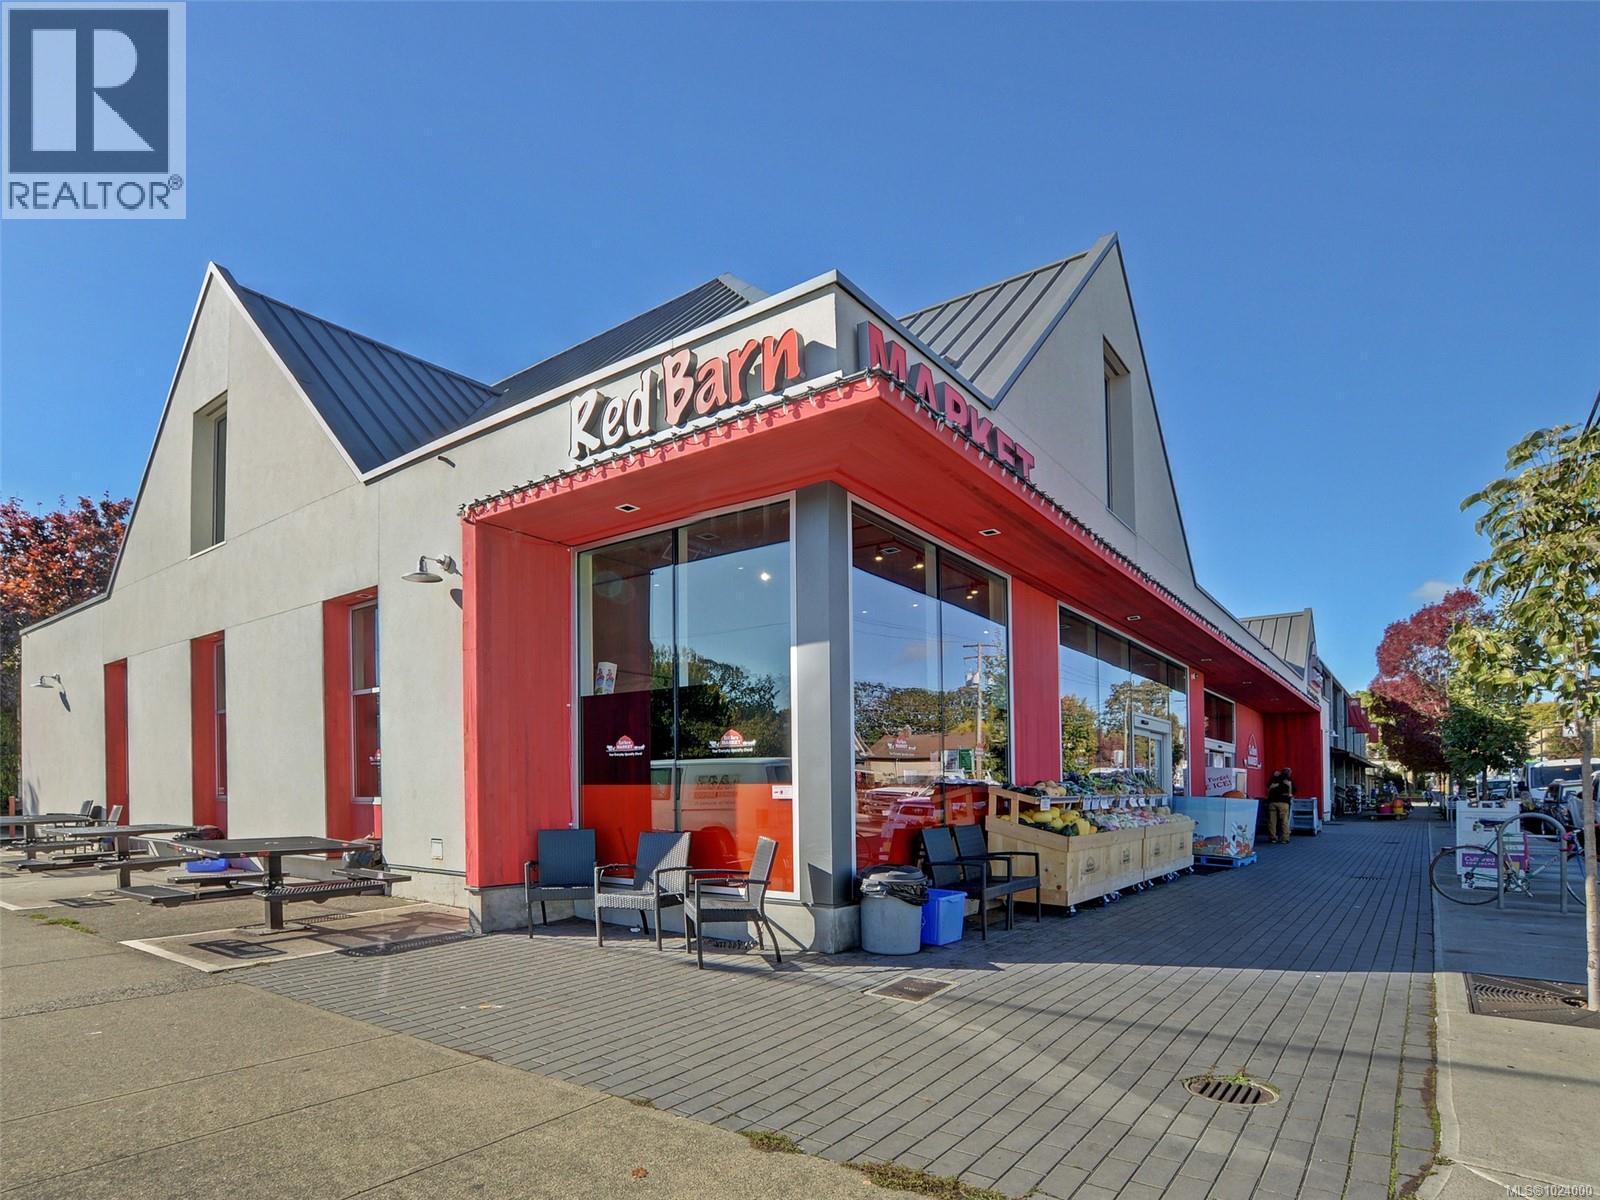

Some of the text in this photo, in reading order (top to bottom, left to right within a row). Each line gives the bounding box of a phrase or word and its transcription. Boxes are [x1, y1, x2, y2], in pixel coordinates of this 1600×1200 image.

[567, 327, 801, 459] Red Barn
[862, 319, 1036, 480] MARKET
